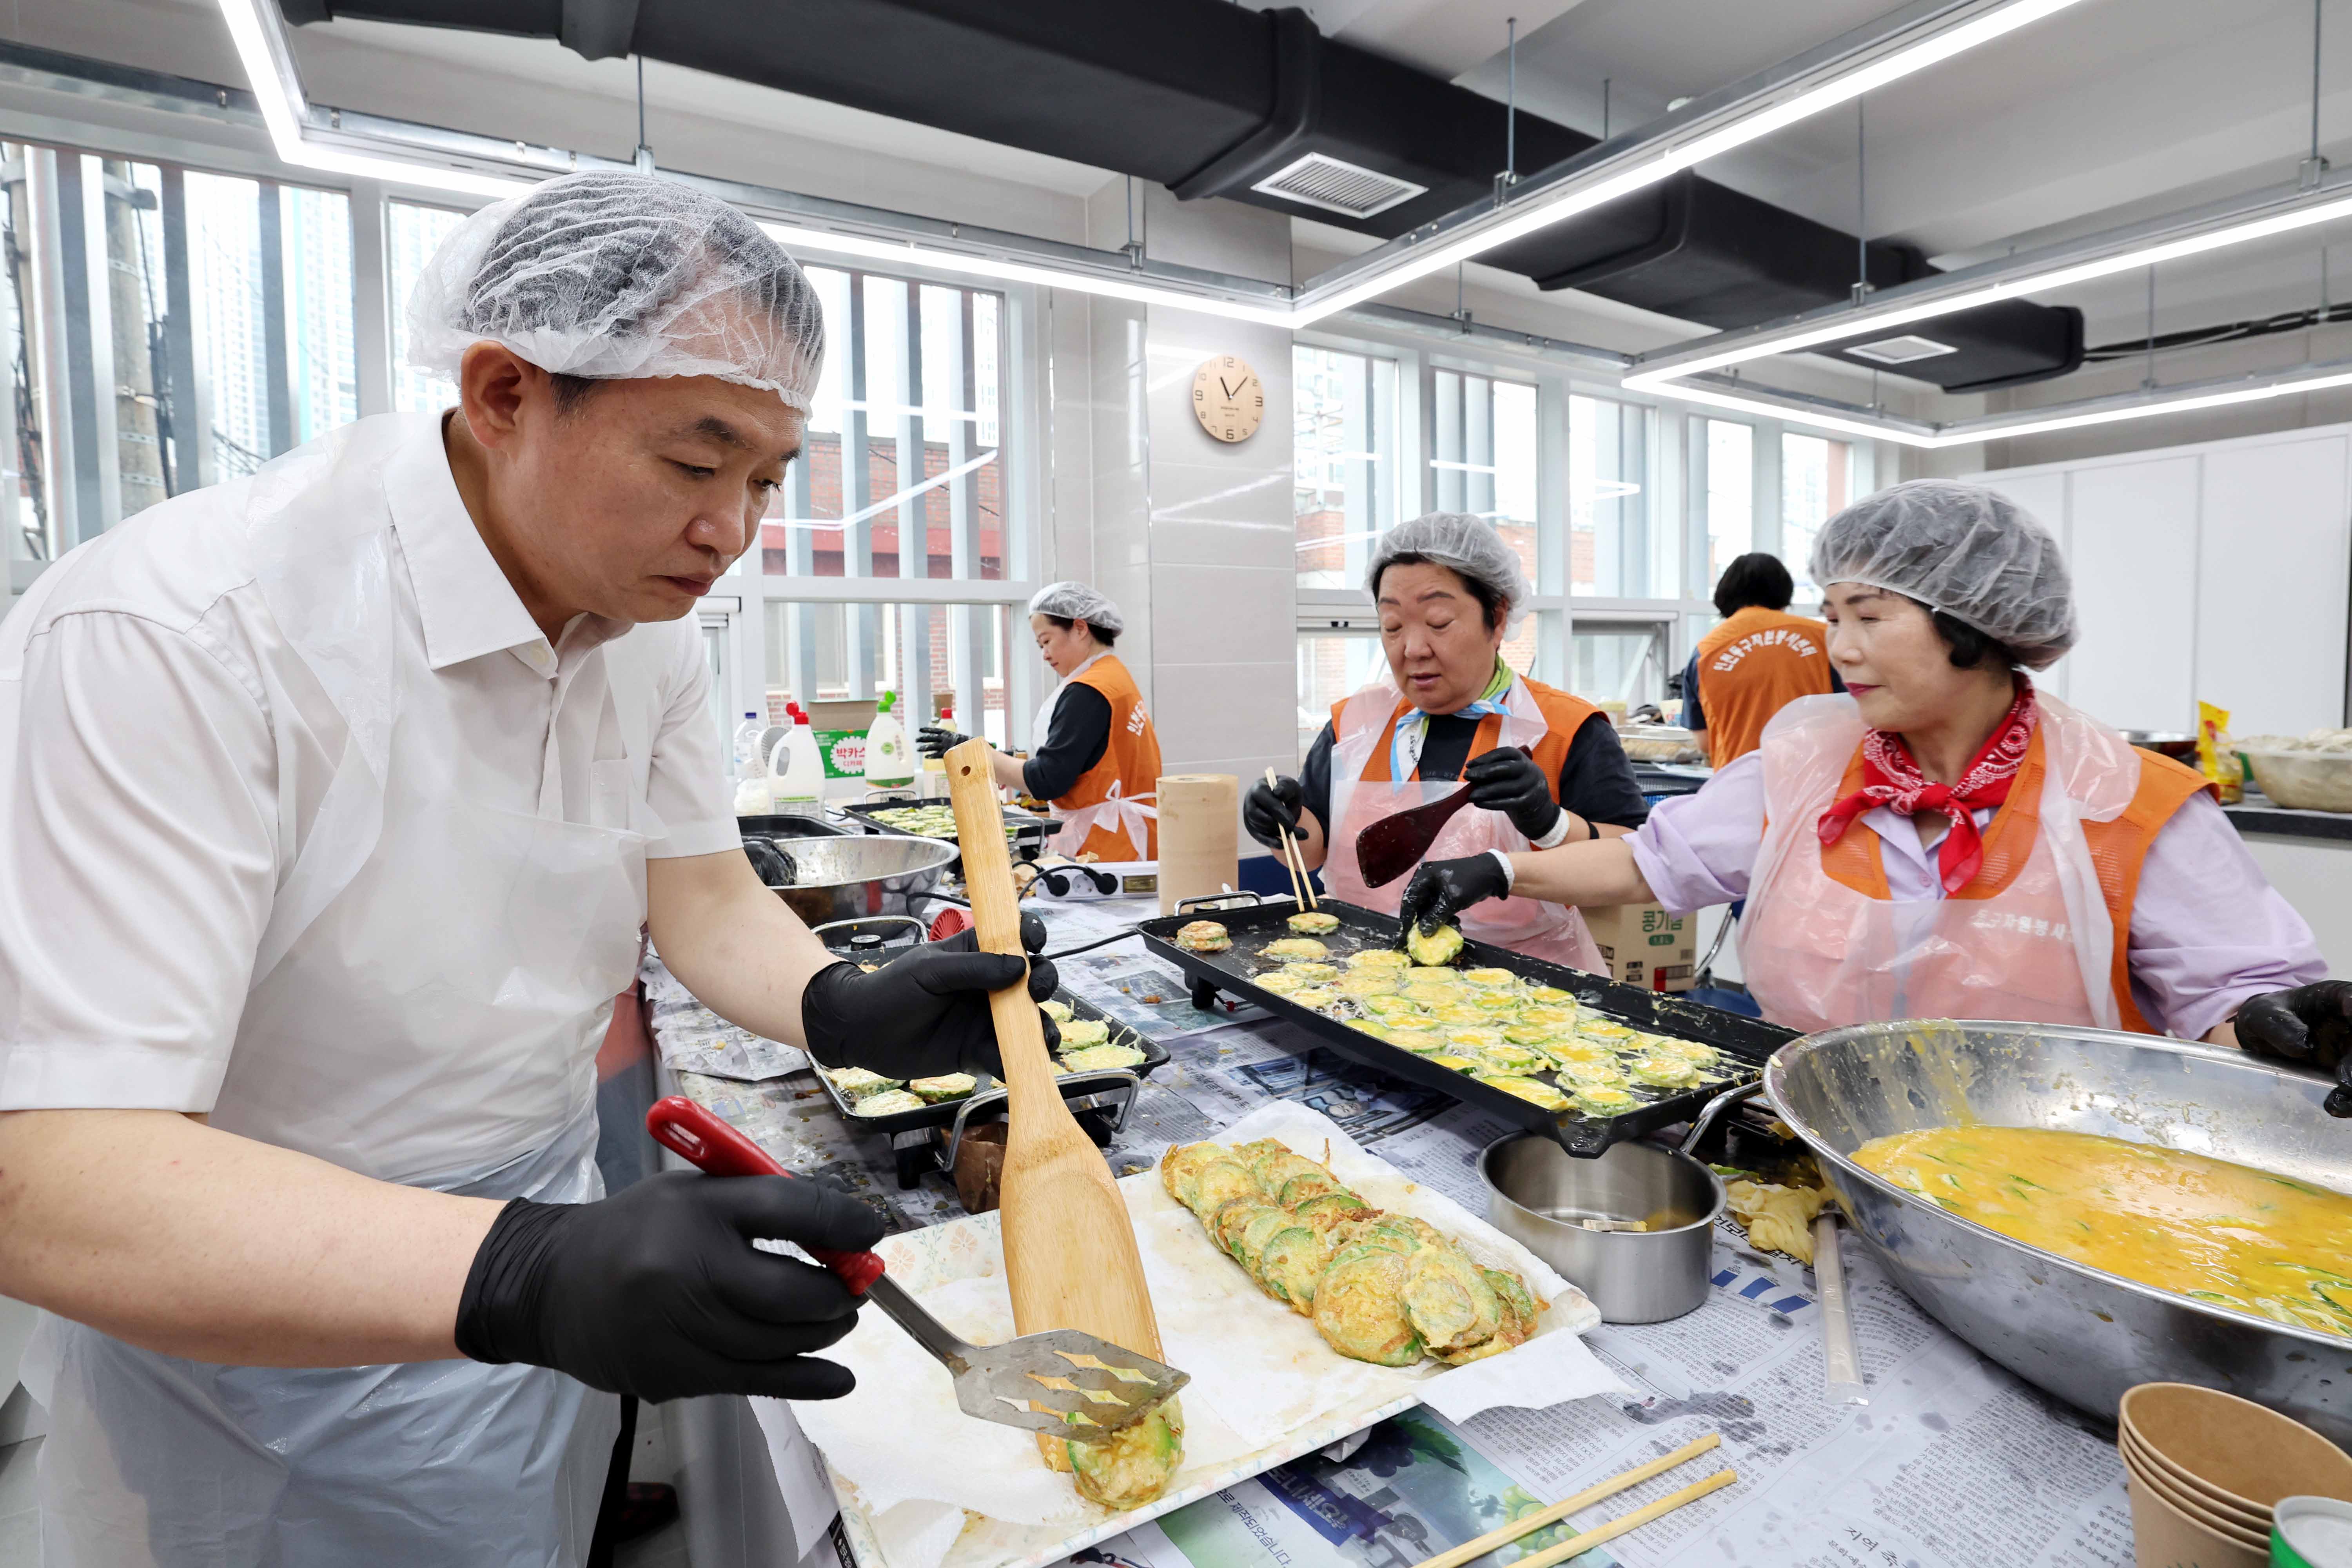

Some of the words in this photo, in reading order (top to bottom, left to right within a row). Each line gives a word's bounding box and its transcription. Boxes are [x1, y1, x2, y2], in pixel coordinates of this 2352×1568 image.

[1224, 357, 1234, 368] 12
[1226, 429, 1234, 440] 6
[1229, 1502, 1292, 1568] 제작되었습니다.
[1843, 1526, 1879, 1552] 지역
[1881, 1550, 1908, 1568] 축
